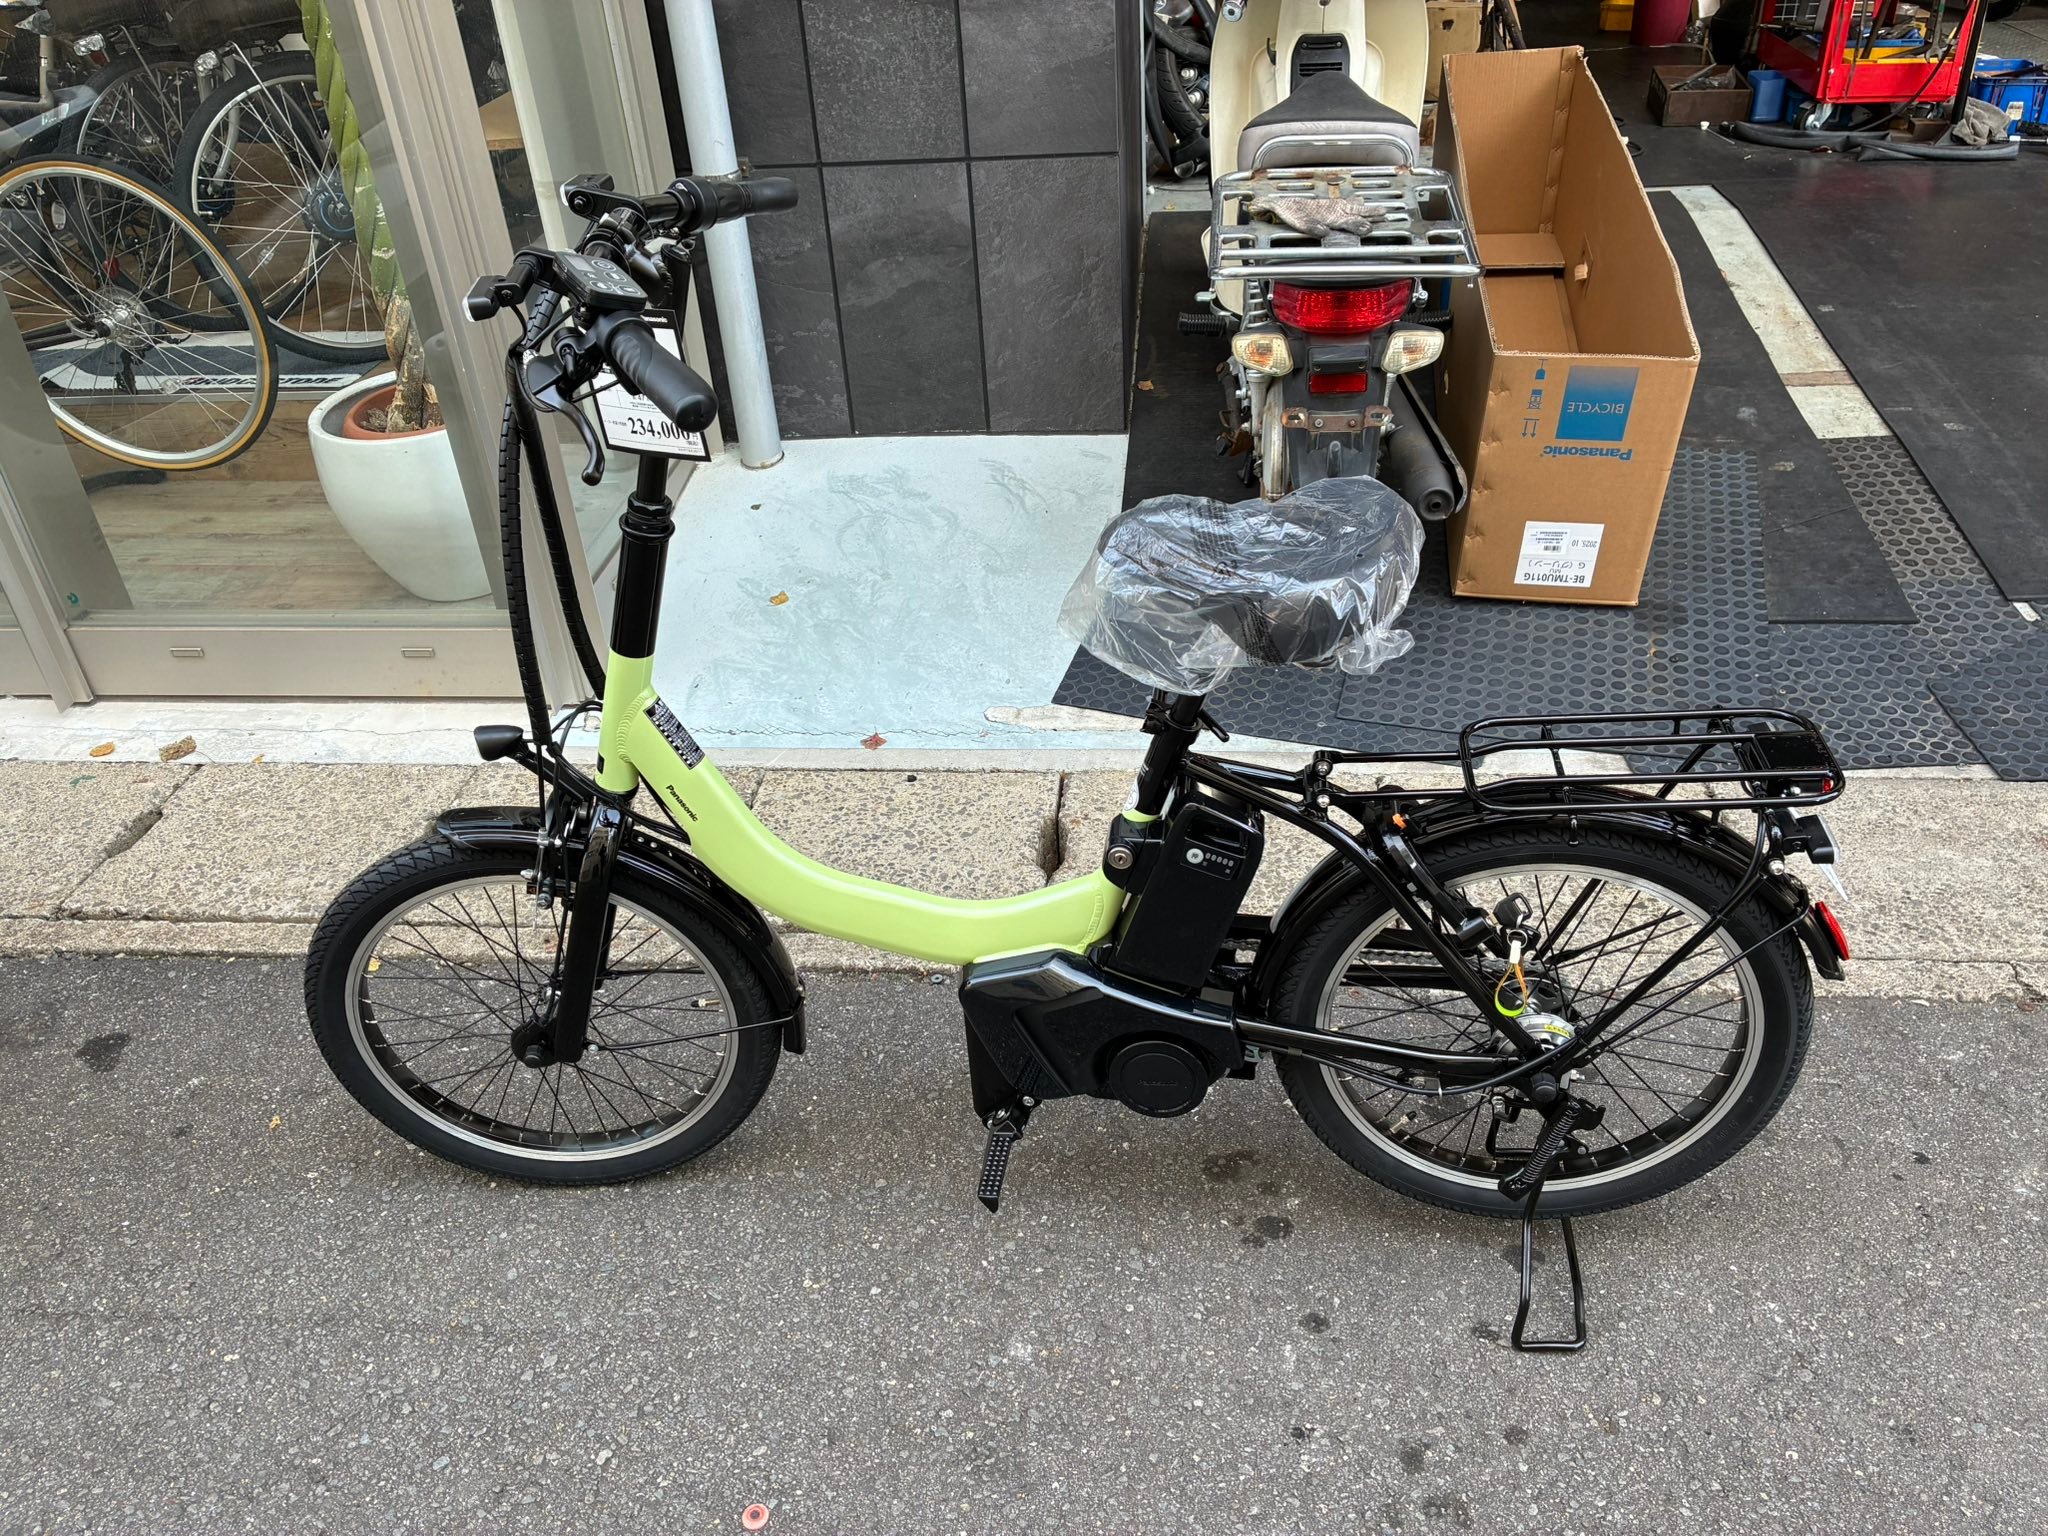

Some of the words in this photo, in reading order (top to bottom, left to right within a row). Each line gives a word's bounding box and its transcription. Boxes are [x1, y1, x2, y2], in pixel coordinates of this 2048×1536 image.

[1567, 401, 1625, 414] BICYCLE
[1543, 445, 1633, 461] Panasonic
[1523, 572, 1586, 584] BE-TMU011G
[665, 784, 699, 822] Panasonic
